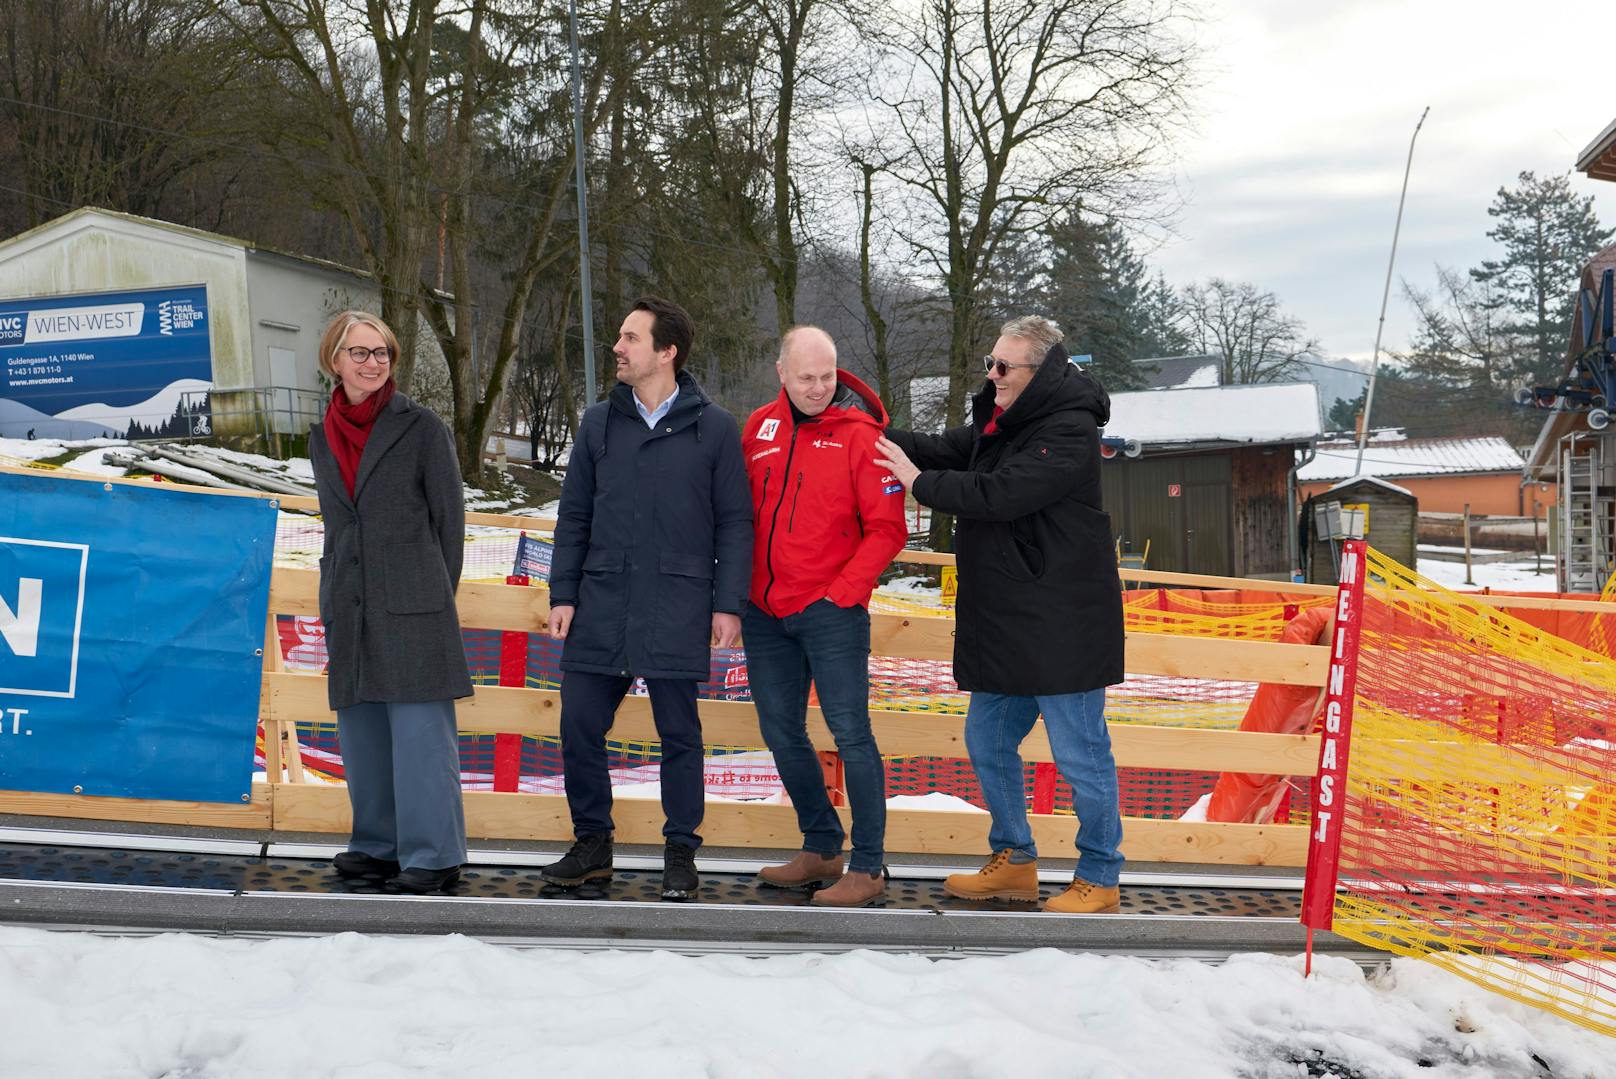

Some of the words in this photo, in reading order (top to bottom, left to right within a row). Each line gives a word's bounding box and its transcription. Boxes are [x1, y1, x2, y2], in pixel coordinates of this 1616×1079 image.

[172, 304, 194, 314] TRAIL
[172, 311, 203, 321] CENTER
[34, 311, 136, 334] WIEN-WEST
[173, 320, 194, 329] WIEN
[7, 357, 48, 366] Guldengasse
[60, 353, 77, 362] 1140
[76, 352, 95, 361] Wien
[9, 376, 74, 387] www.mvcmotors.at
[760, 422, 777, 437] A1
[1315, 552, 1358, 843] MEINGAST
